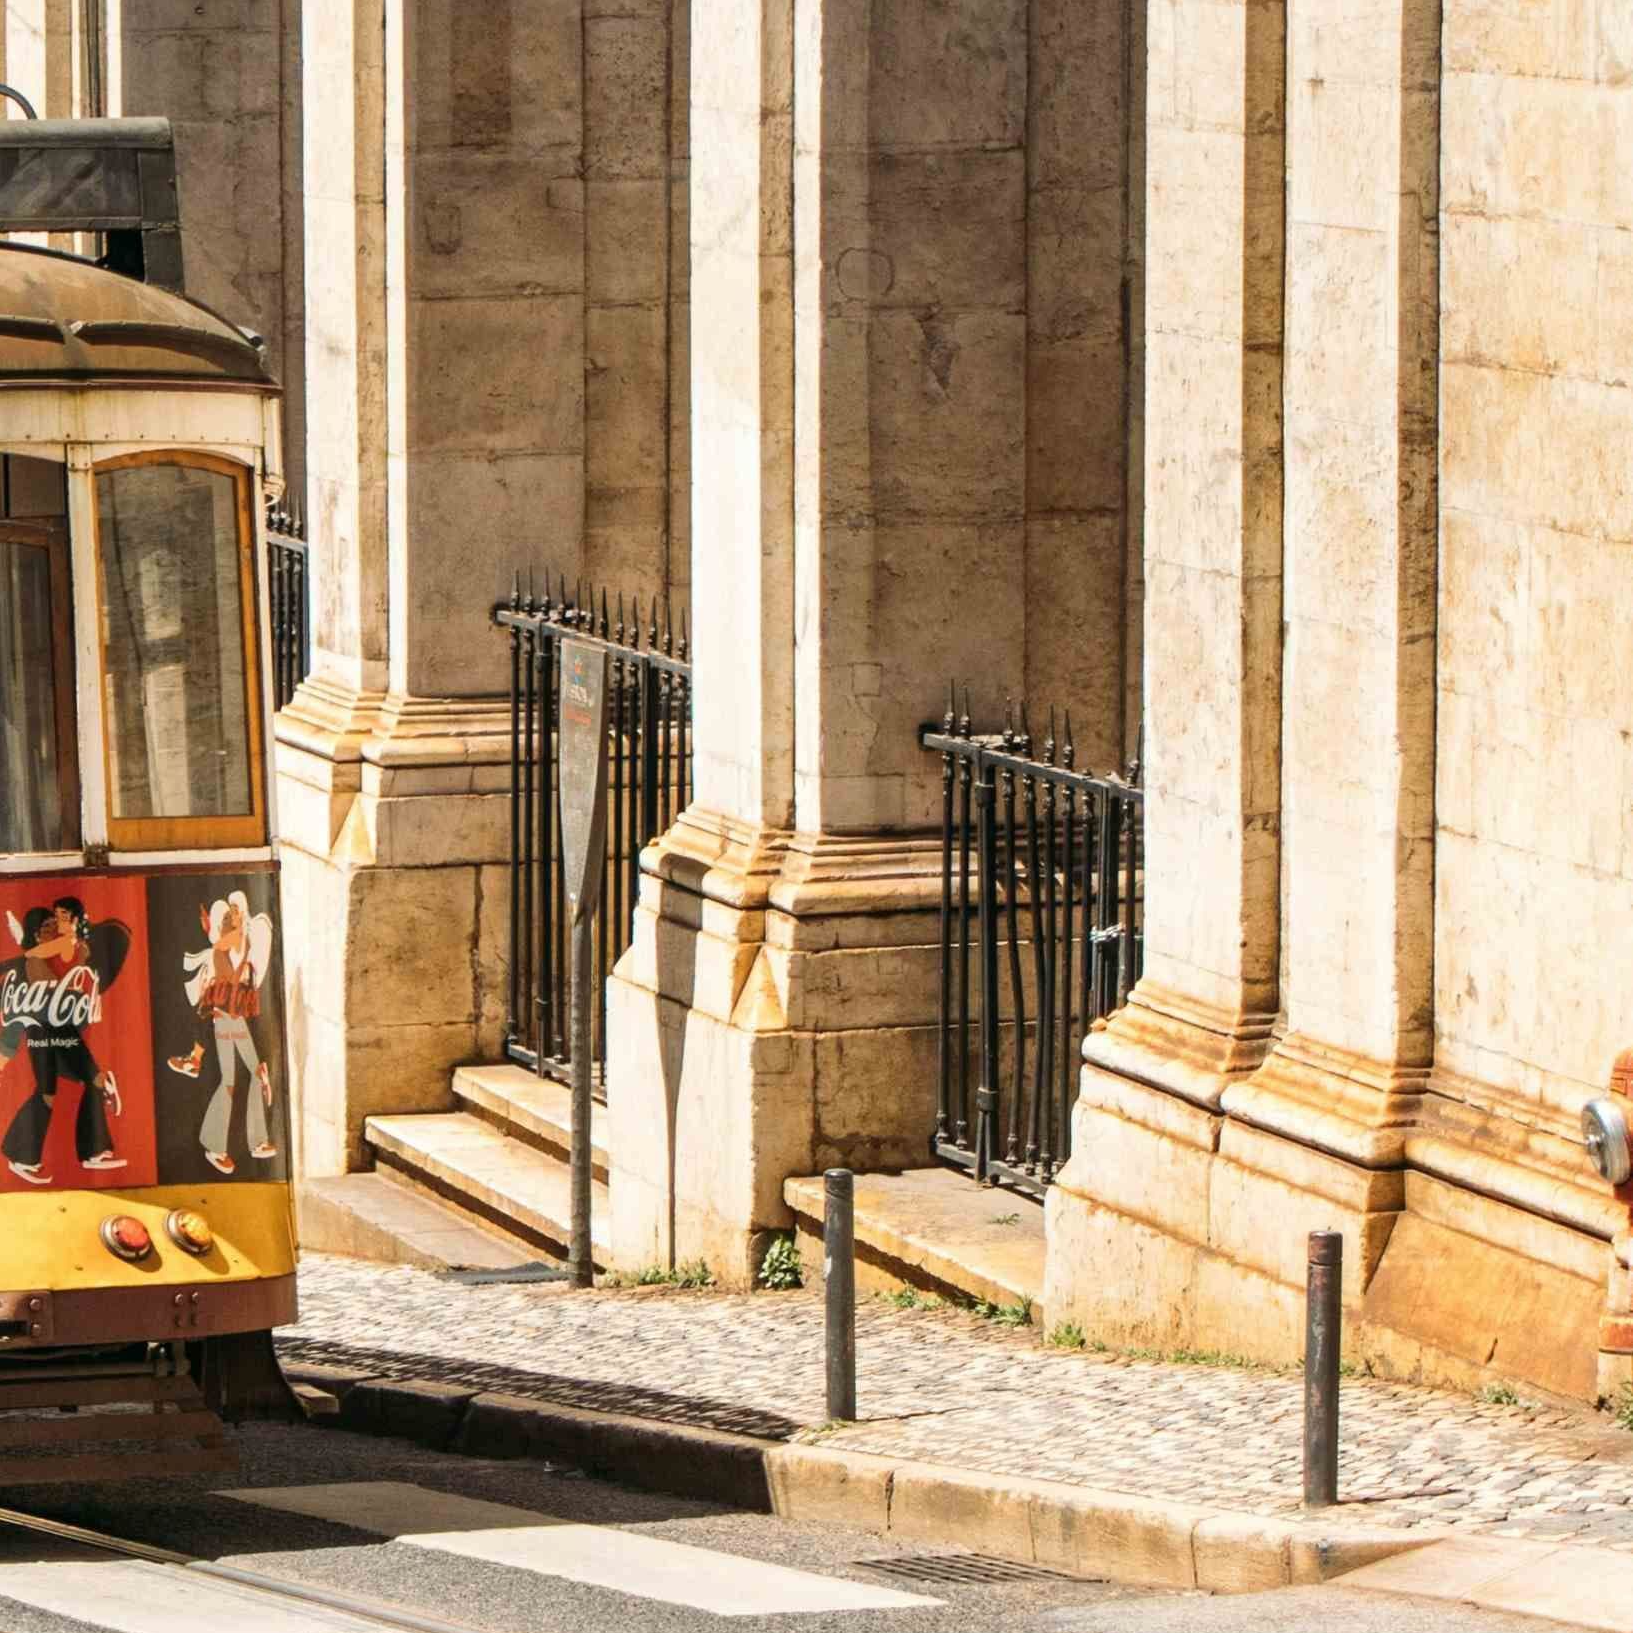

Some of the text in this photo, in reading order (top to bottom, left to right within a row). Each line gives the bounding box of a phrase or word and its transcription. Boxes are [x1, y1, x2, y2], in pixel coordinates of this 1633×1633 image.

[0, 965, 103, 1027] Coca-Cola
[27, 1037, 79, 1049] Real Magic
